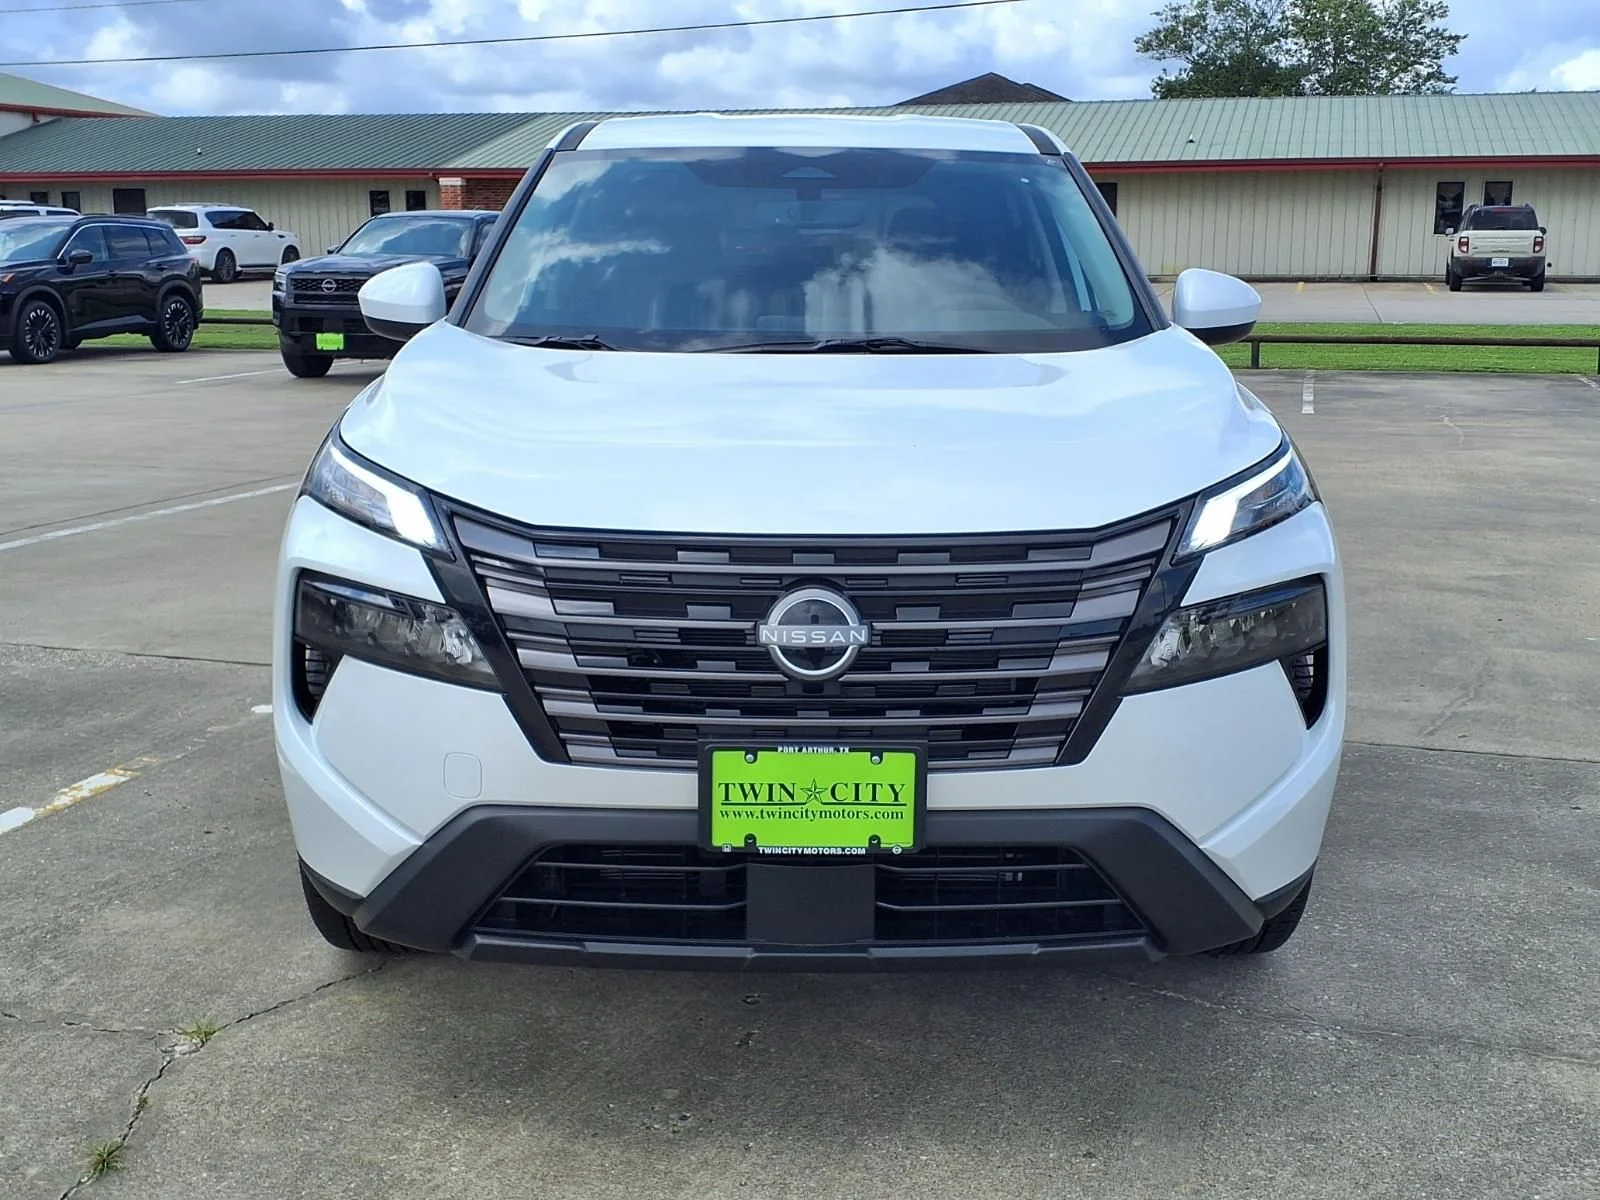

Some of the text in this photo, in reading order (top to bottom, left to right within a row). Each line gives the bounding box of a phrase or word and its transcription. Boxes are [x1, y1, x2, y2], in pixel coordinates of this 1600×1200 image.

[762, 629, 865, 643] NISSAN
[777, 745, 800, 754] PORT
[839, 745, 850, 754] TX
[718, 782, 906, 803] TWIN CITY
[720, 806, 904, 822] www.twincitymotors.com
[758, 846, 866, 855] TWINCITYMOTORS.COM
